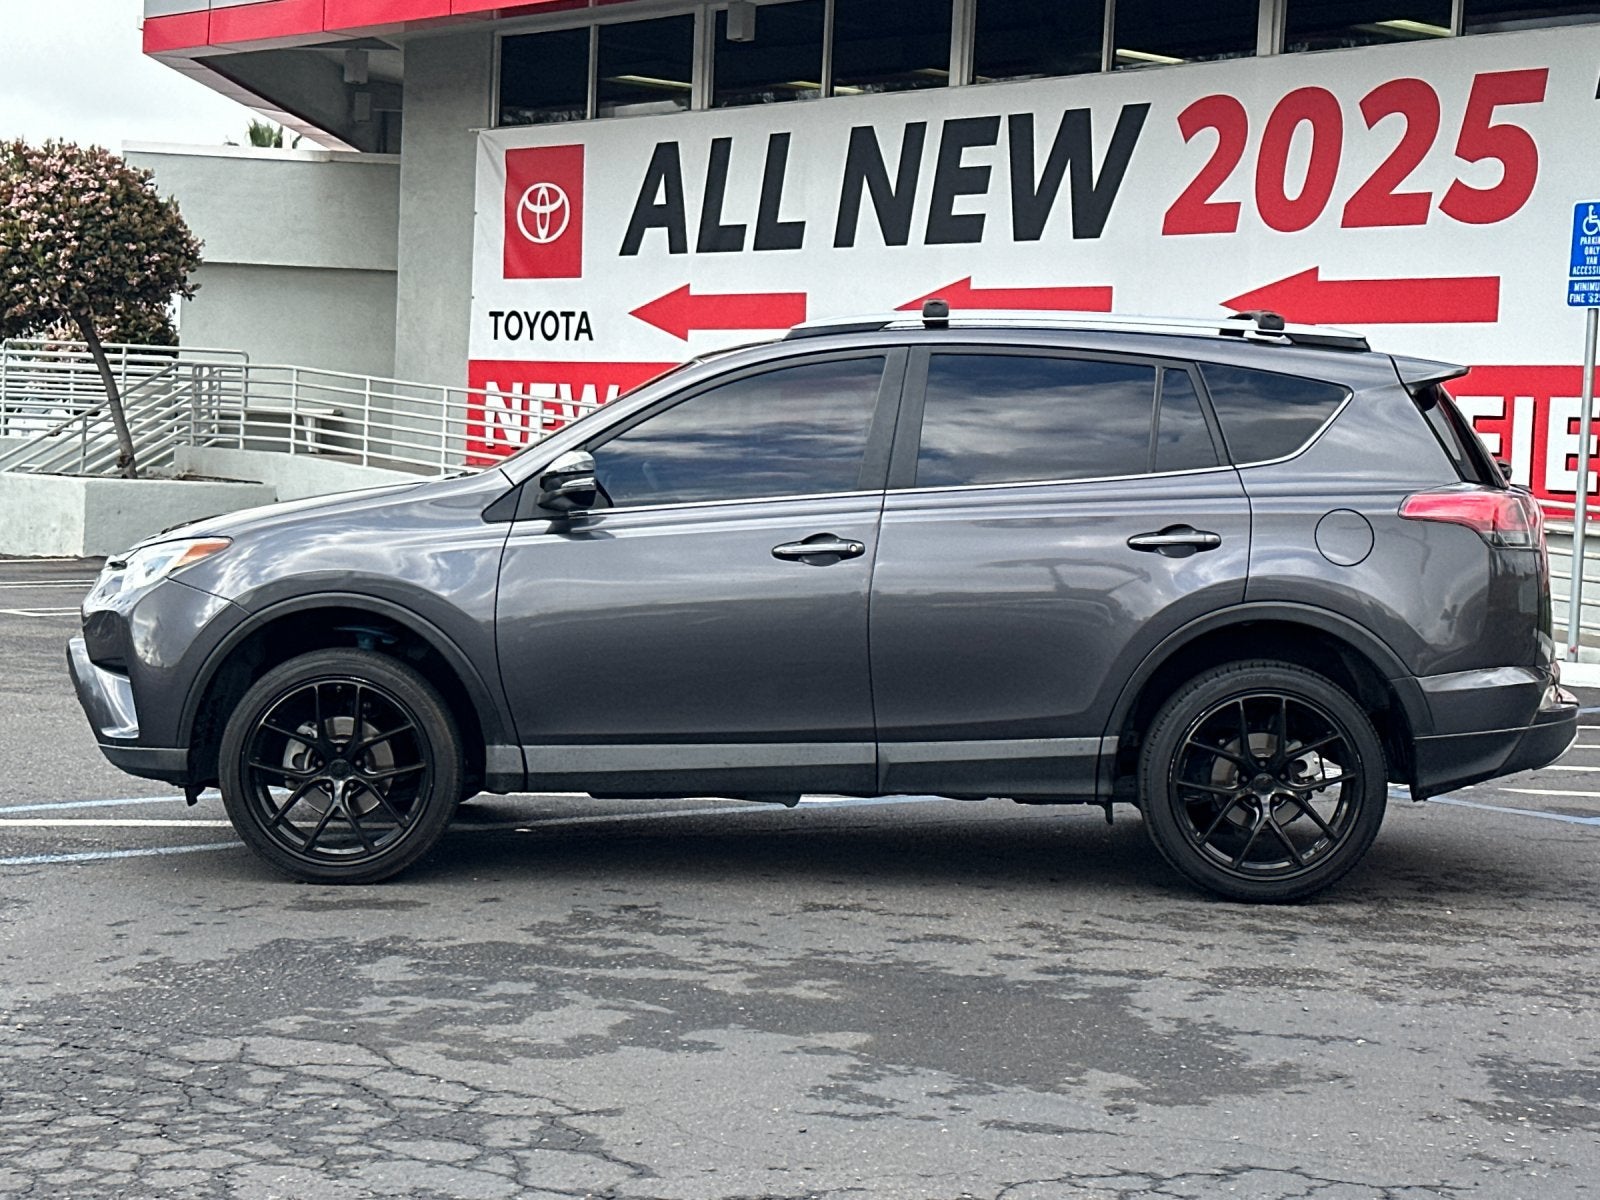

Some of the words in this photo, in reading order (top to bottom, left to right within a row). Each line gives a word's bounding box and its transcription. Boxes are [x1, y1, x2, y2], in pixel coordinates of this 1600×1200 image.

[618, 132, 807, 257] ALL
[832, 102, 1153, 249] NEW
[1161, 67, 1550, 236] 2025
[1584, 246, 1600, 256] ONLY
[1586, 255, 1598, 265] VAN
[1572, 265, 1600, 275] ACCESSI
[1569, 292, 1586, 304] FINE
[488, 310, 594, 342] TOYOTA
